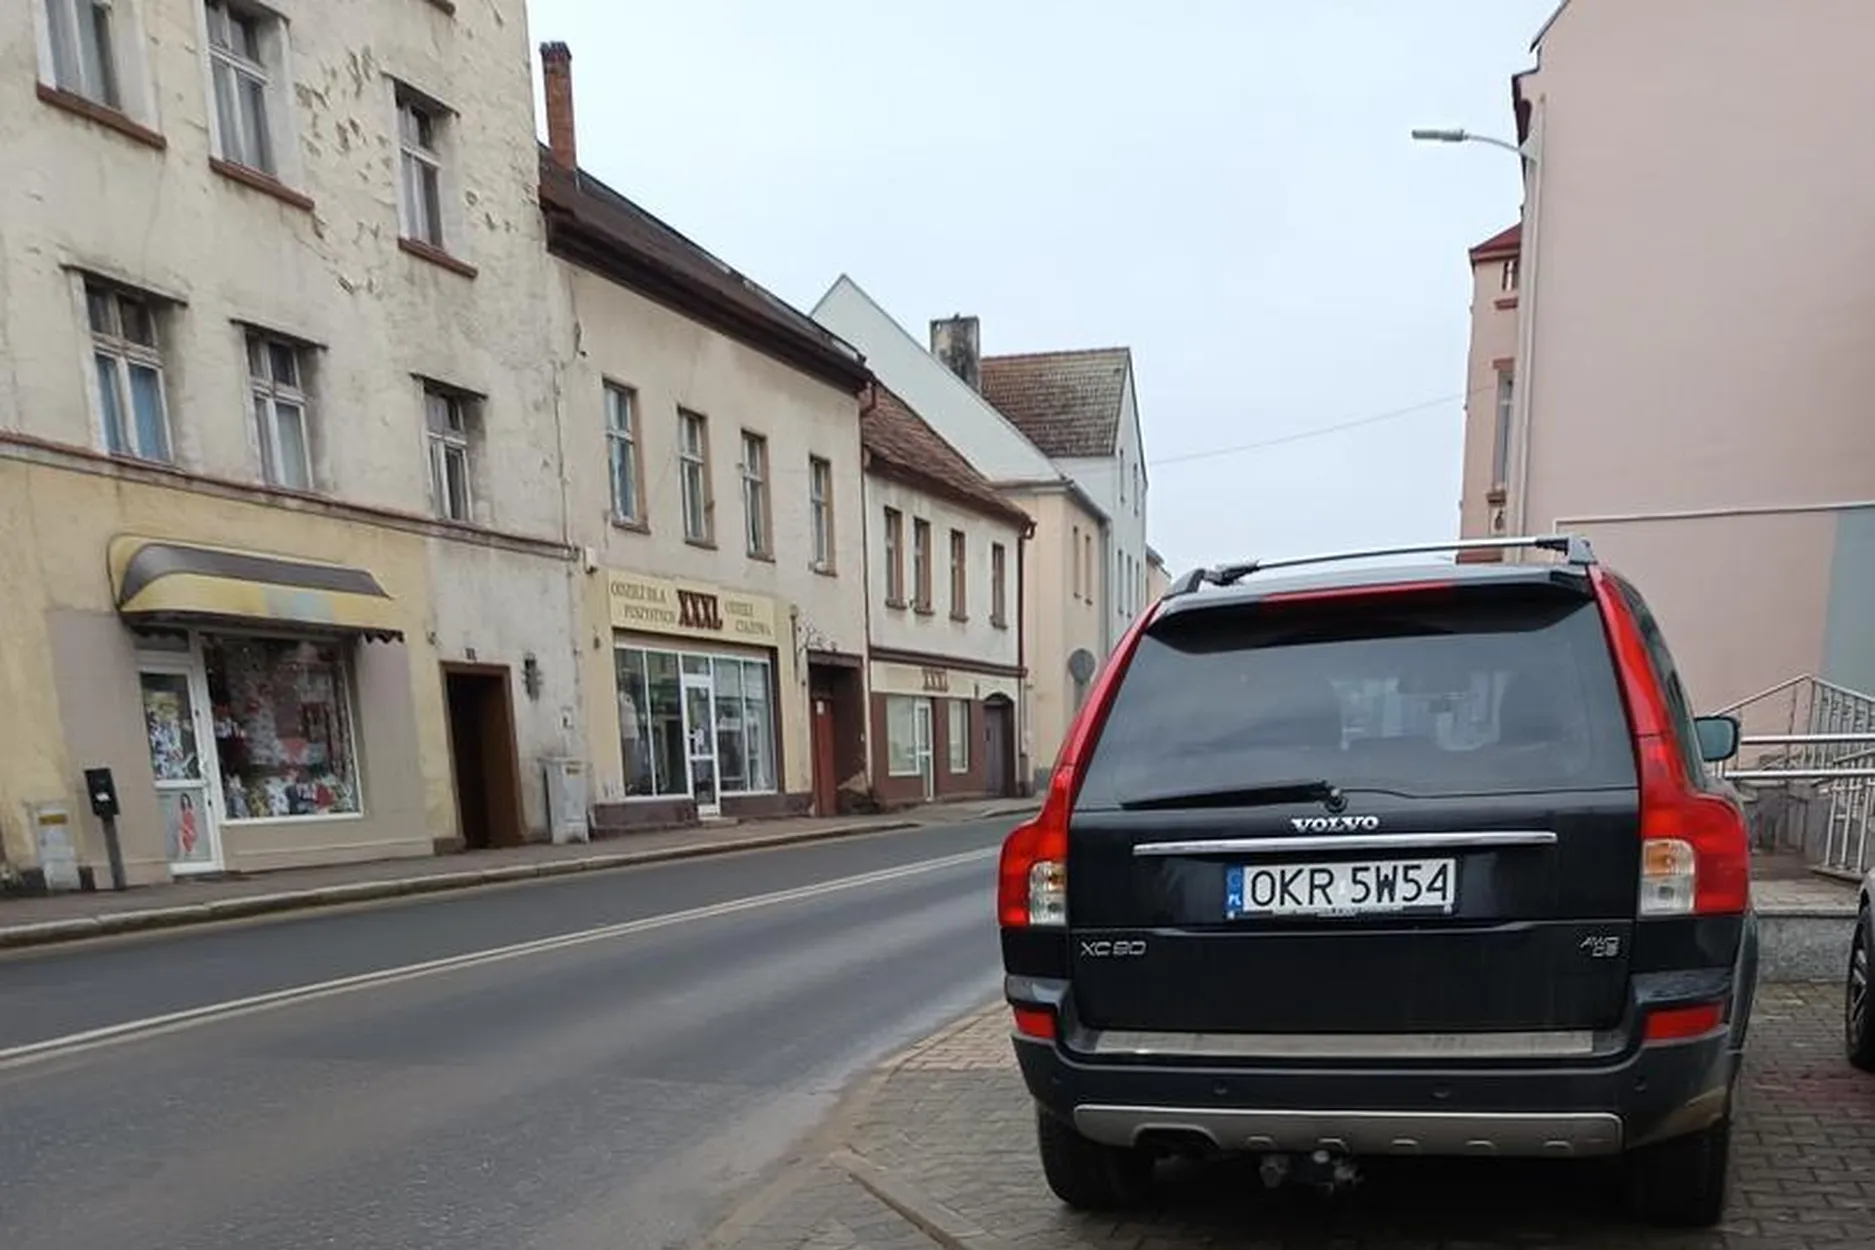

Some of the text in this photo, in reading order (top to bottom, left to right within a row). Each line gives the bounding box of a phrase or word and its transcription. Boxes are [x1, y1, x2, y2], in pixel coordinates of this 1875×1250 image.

[676, 589, 723, 630] XXXL
[1291, 816, 1379, 832] VOLVO
[1251, 863, 1449, 906] OKR 5W54
[1081, 941, 1146, 957] XC90
